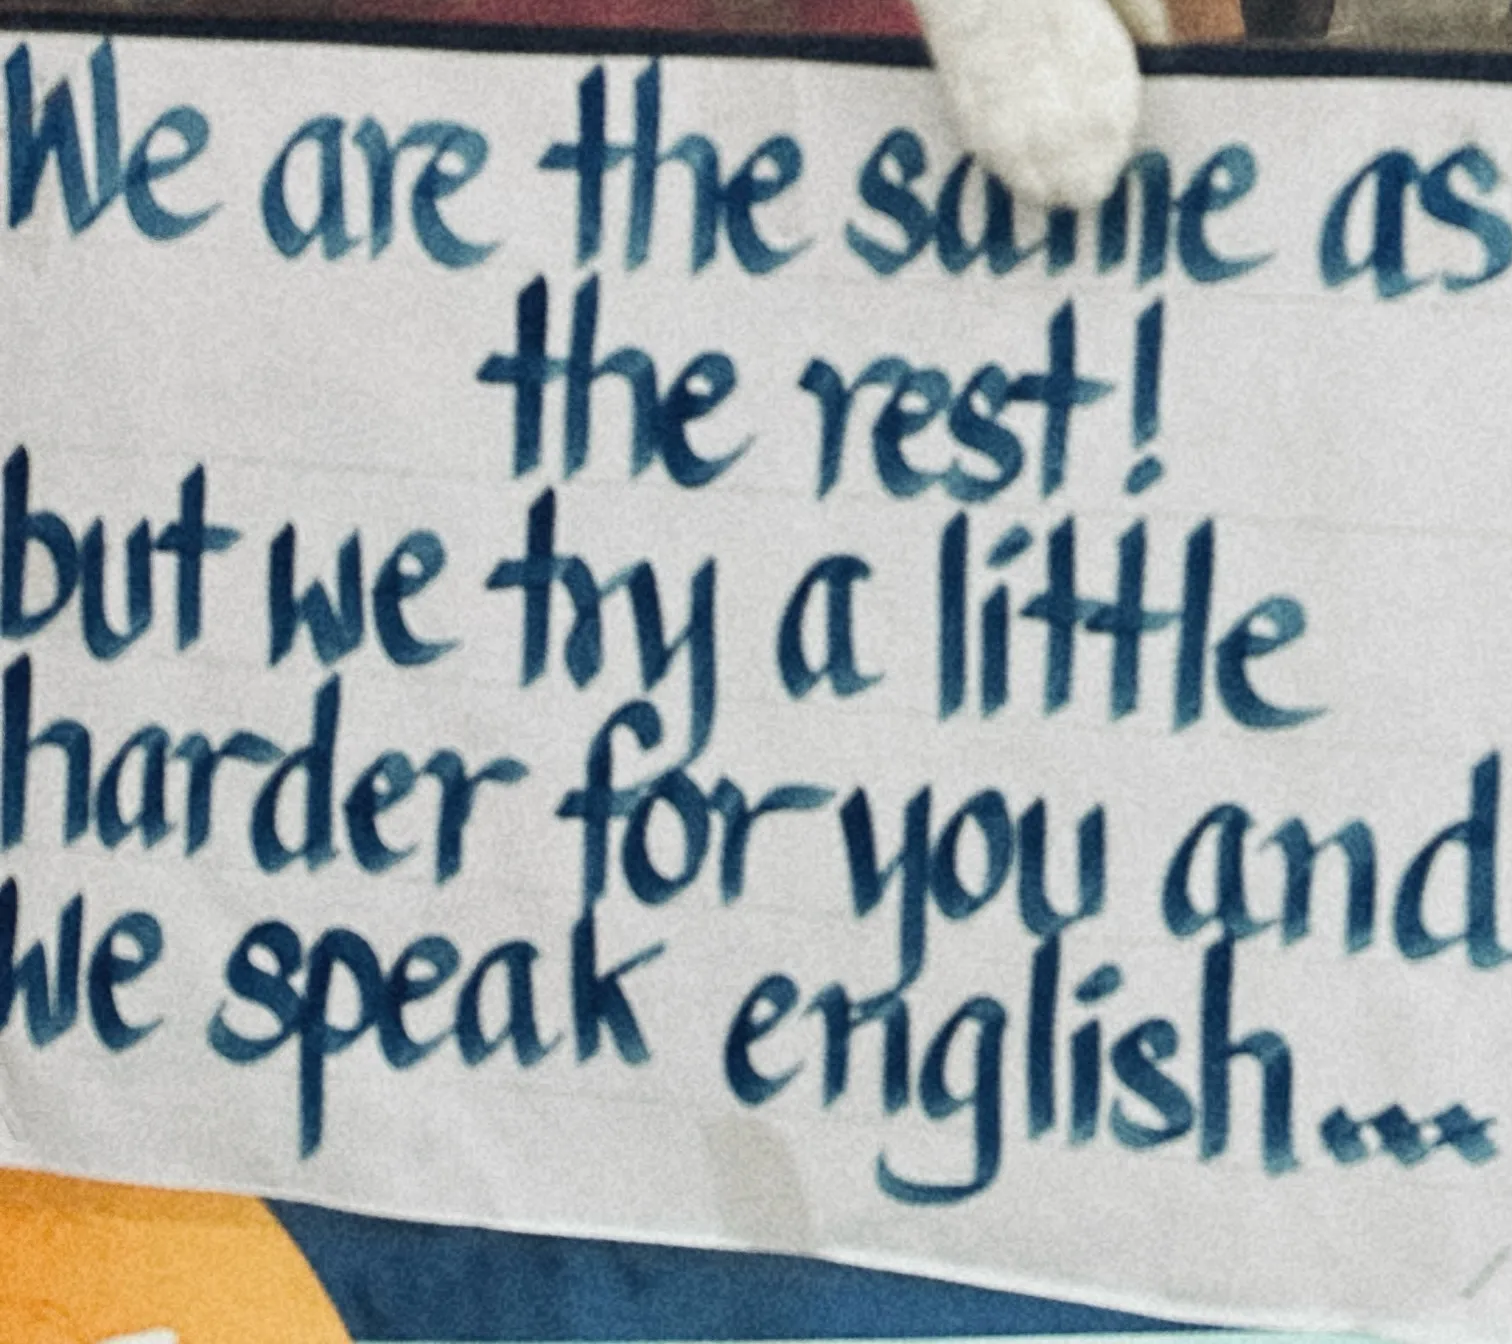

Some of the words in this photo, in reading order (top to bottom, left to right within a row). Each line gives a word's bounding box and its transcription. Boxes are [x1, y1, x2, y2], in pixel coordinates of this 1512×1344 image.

[4, 36, 220, 244] We
[260, 112, 500, 270] are
[536, 54, 814, 279] the
[474, 274, 758, 490] the
[800, 295, 1168, 502] rest!
[0, 444, 240, 662] but
[268, 520, 463, 670] we
[483, 485, 720, 767] try
[775, 550, 884, 702] a
[936, 512, 1335, 734] little
[0, 652, 530, 887] harder
[554, 698, 838, 912] for
[838, 780, 1110, 1007] you
[205, 902, 668, 1162] speak
